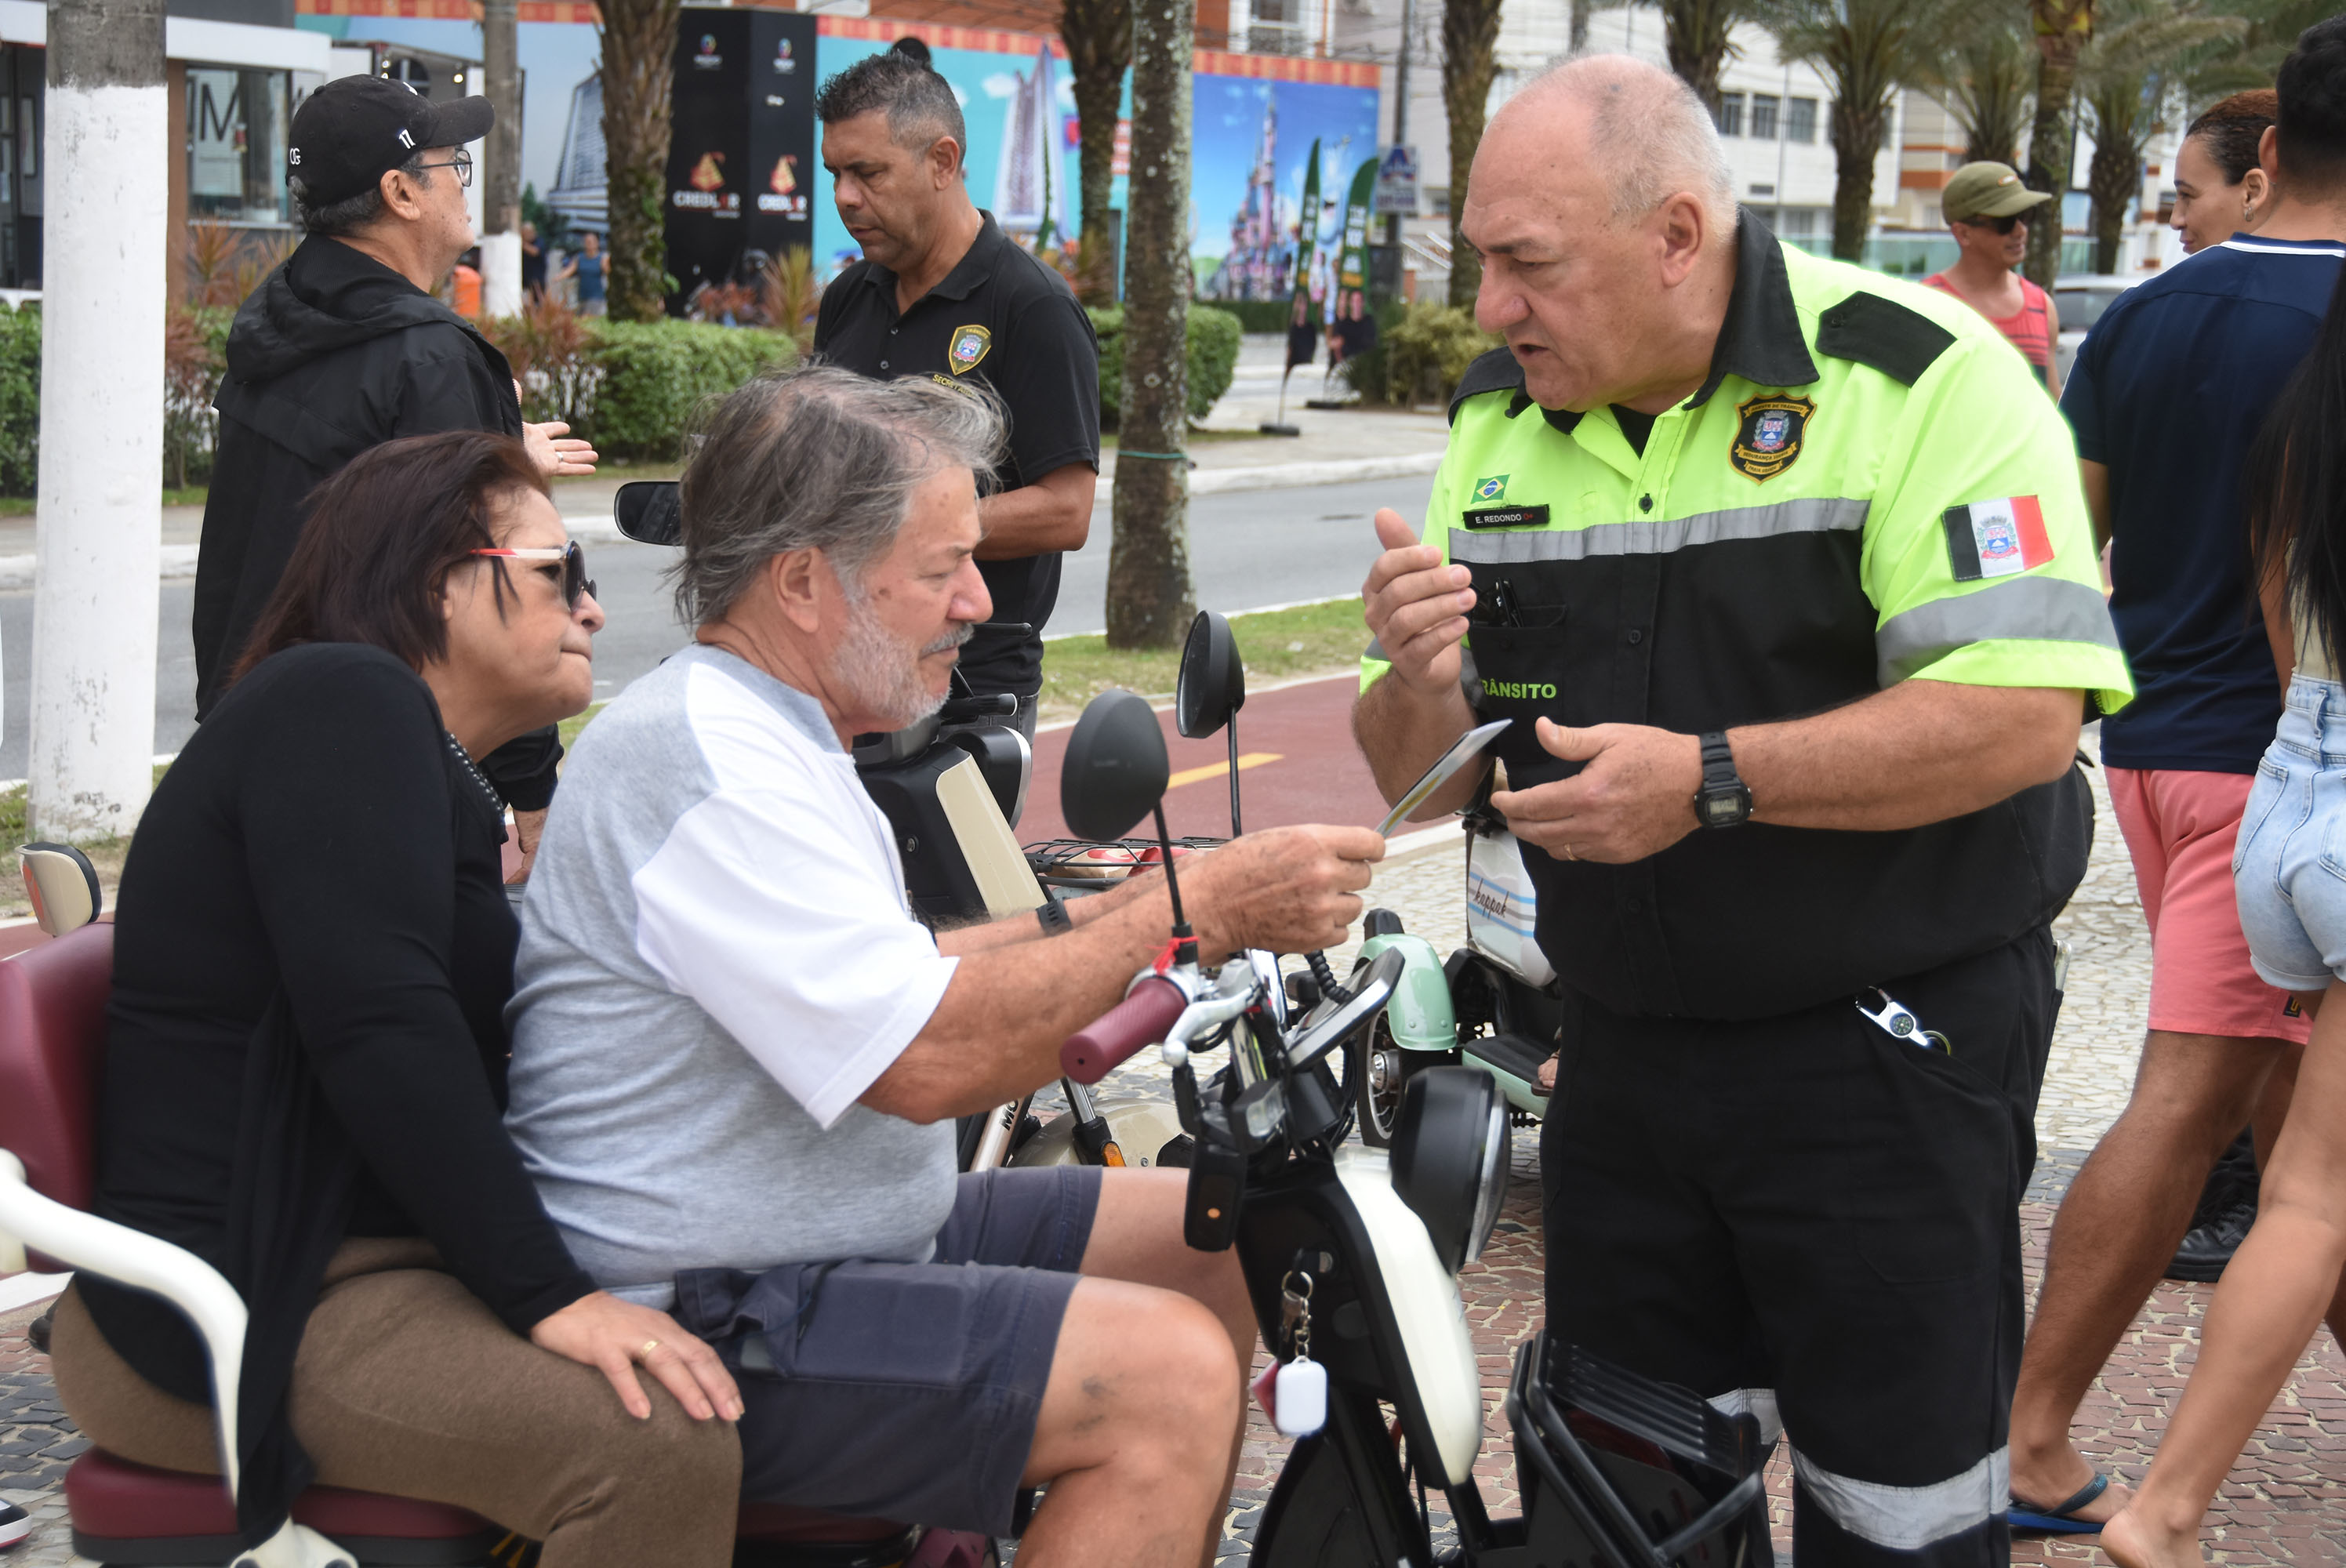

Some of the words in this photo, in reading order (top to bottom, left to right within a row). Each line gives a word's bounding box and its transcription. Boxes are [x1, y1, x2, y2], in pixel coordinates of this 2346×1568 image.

[1475, 516, 1484, 524] E.
[1484, 514, 1522, 523] REDONDO
[1480, 678, 1557, 699] RÂNSITO
